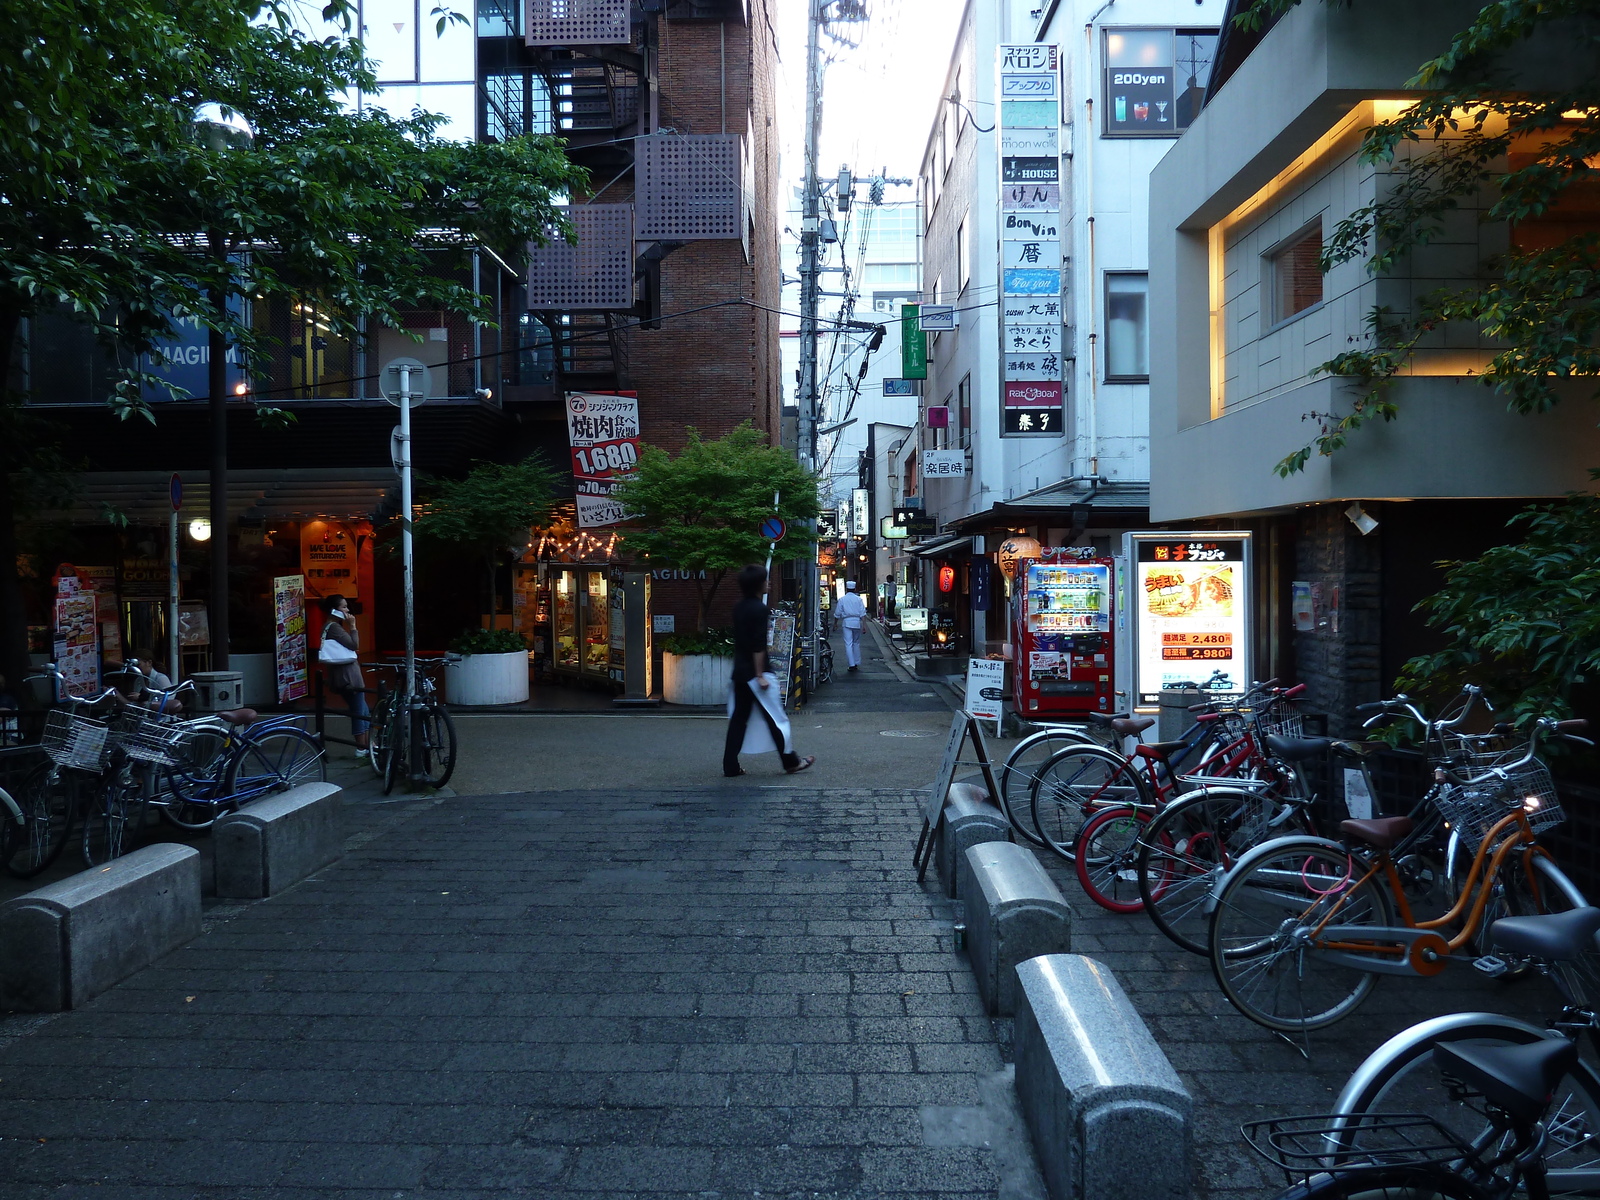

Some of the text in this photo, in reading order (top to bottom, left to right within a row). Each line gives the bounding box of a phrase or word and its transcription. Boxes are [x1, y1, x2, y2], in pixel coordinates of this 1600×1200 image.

[1003, 56, 1047, 69] バロン
[1114, 74, 1165, 85] 200yen
[1002, 140, 1032, 149] moon
[1021, 169, 1057, 178] HOUSE
[1012, 186, 1048, 203] けん
[1006, 215, 1031, 228] Bon
[1019, 243, 1042, 264] 暦
[1013, 336, 1051, 349] おぐら
[571, 415, 614, 439] 焼肉
[614, 415, 637, 427] 食べ
[309, 544, 346, 552] WE LOVE
[1144, 573, 1185, 593] うまい
